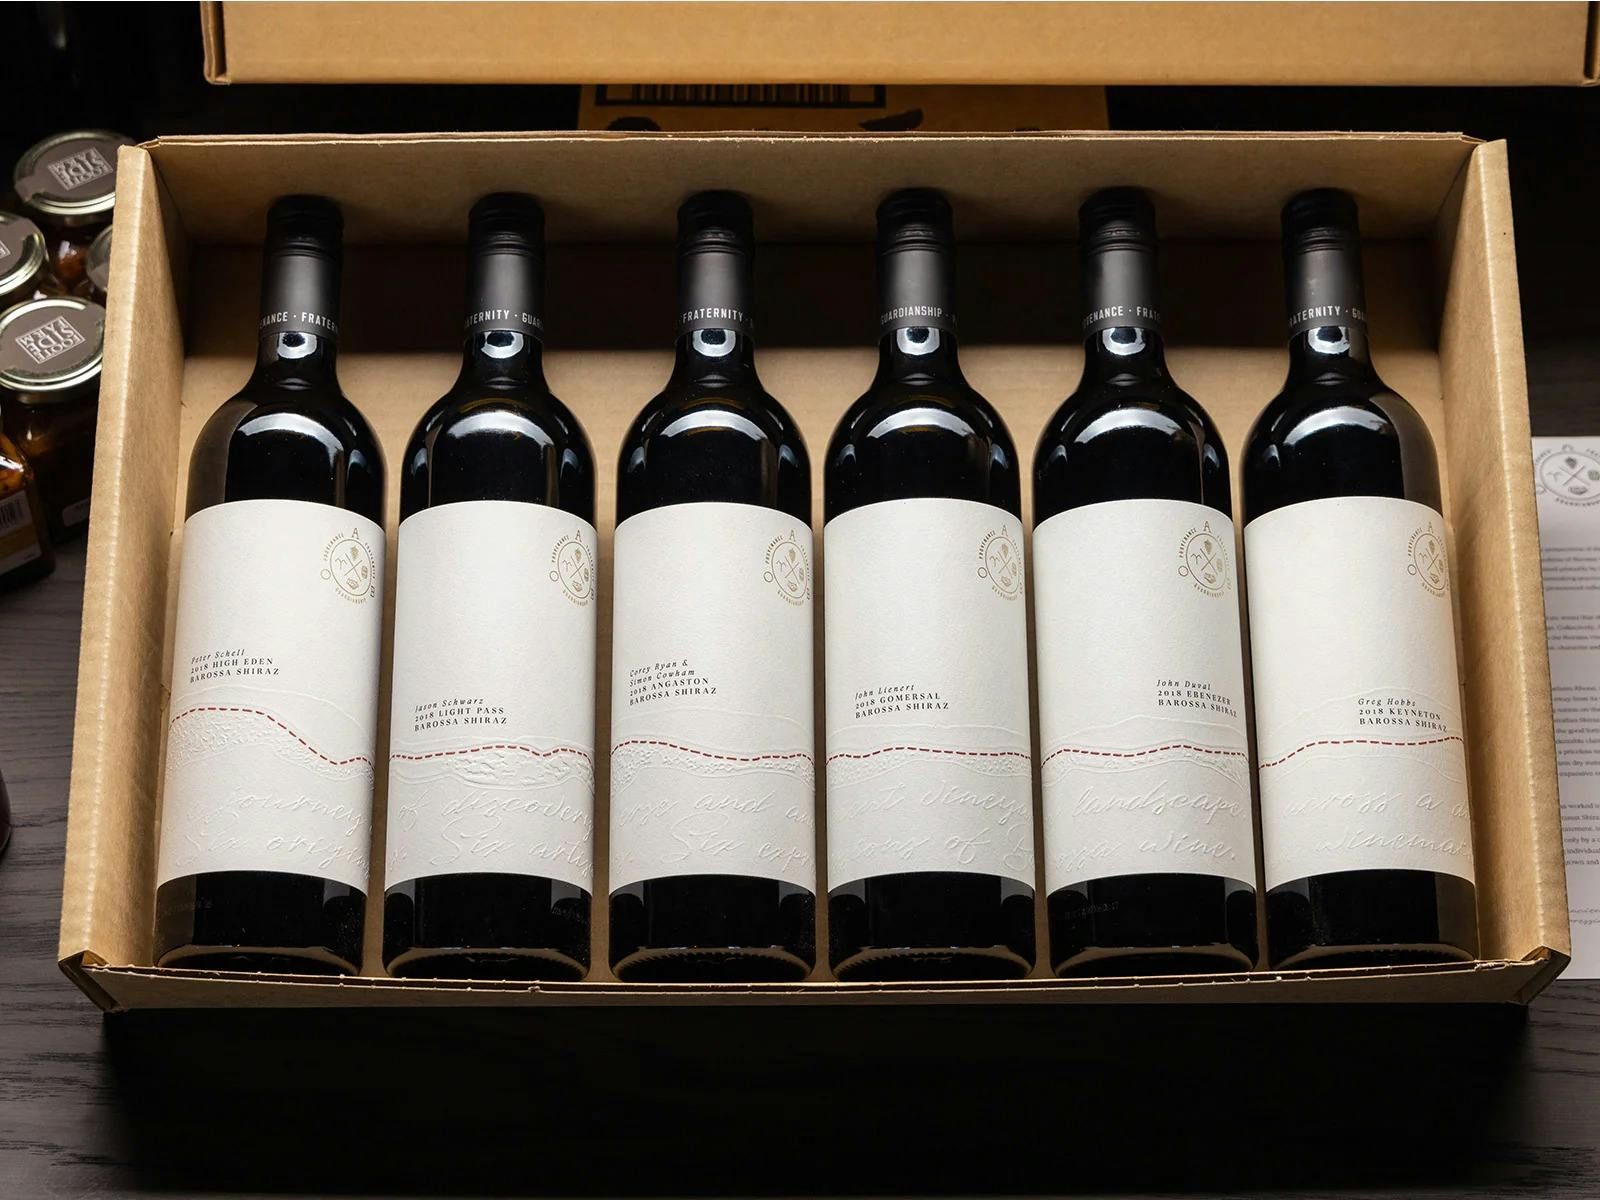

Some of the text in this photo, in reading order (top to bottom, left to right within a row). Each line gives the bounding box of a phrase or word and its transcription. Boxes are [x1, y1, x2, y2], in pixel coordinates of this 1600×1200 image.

[682, 307, 743, 324] FRATERNITY
[191, 649, 245, 664] Peter Schell
[191, 658, 273, 674] 2018 HIGH EDEN
[629, 659, 688, 677] Corey Ryan &
[190, 668, 280, 683] BAROSSA SHIRAZ
[629, 669, 695, 687] Simon Cowham
[629, 677, 709, 697] 2018 ANGASTON
[855, 684, 914, 700] John Lienert
[1157, 679, 1211, 690] John Duval
[629, 687, 717, 706] BAROSSA SHIRAZ
[855, 692, 941, 709] 2018 GOMERSAL
[1186, 690, 1232, 706] EBENEZER
[1358, 698, 1416, 707] Greg Hobbs
[415, 698, 484, 713] Jason Schwarz
[855, 702, 949, 719] BAROSSA SHIRAZ
[1158, 699, 1238, 718] BAROSSA SHIRAZ
[415, 707, 505, 722] 2018 LIGHT PASS
[1389, 708, 1441, 721] KEYNETON
[414, 717, 507, 732] BAROSSA SHIRAZ
[1360, 717, 1448, 733] BAROSSA SHIRAZ
